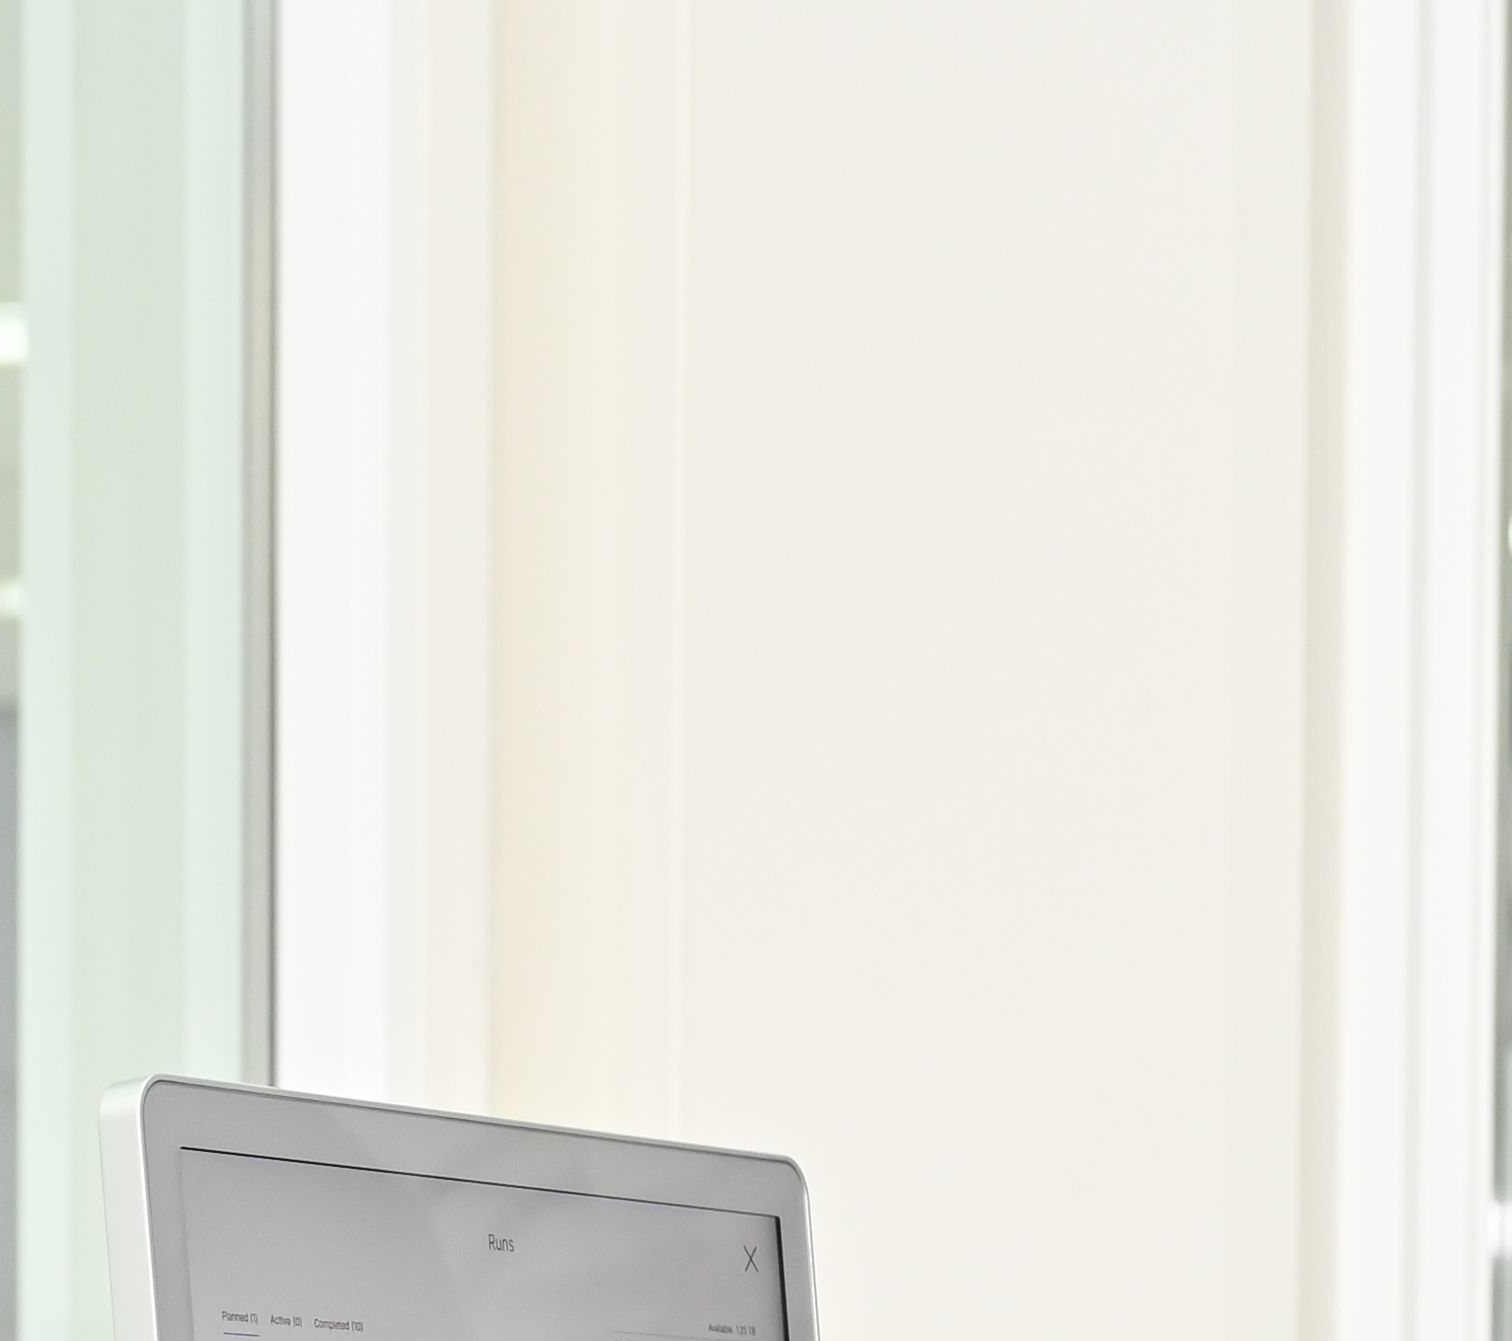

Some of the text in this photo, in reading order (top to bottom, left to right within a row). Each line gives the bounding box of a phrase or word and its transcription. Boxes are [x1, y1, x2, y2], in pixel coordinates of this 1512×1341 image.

[487, 1233, 515, 1253] Runs
[221, 1310, 249, 1323] Planned
[270, 1314, 291, 1326] Active
[314, 1318, 350, 1331] Completed
